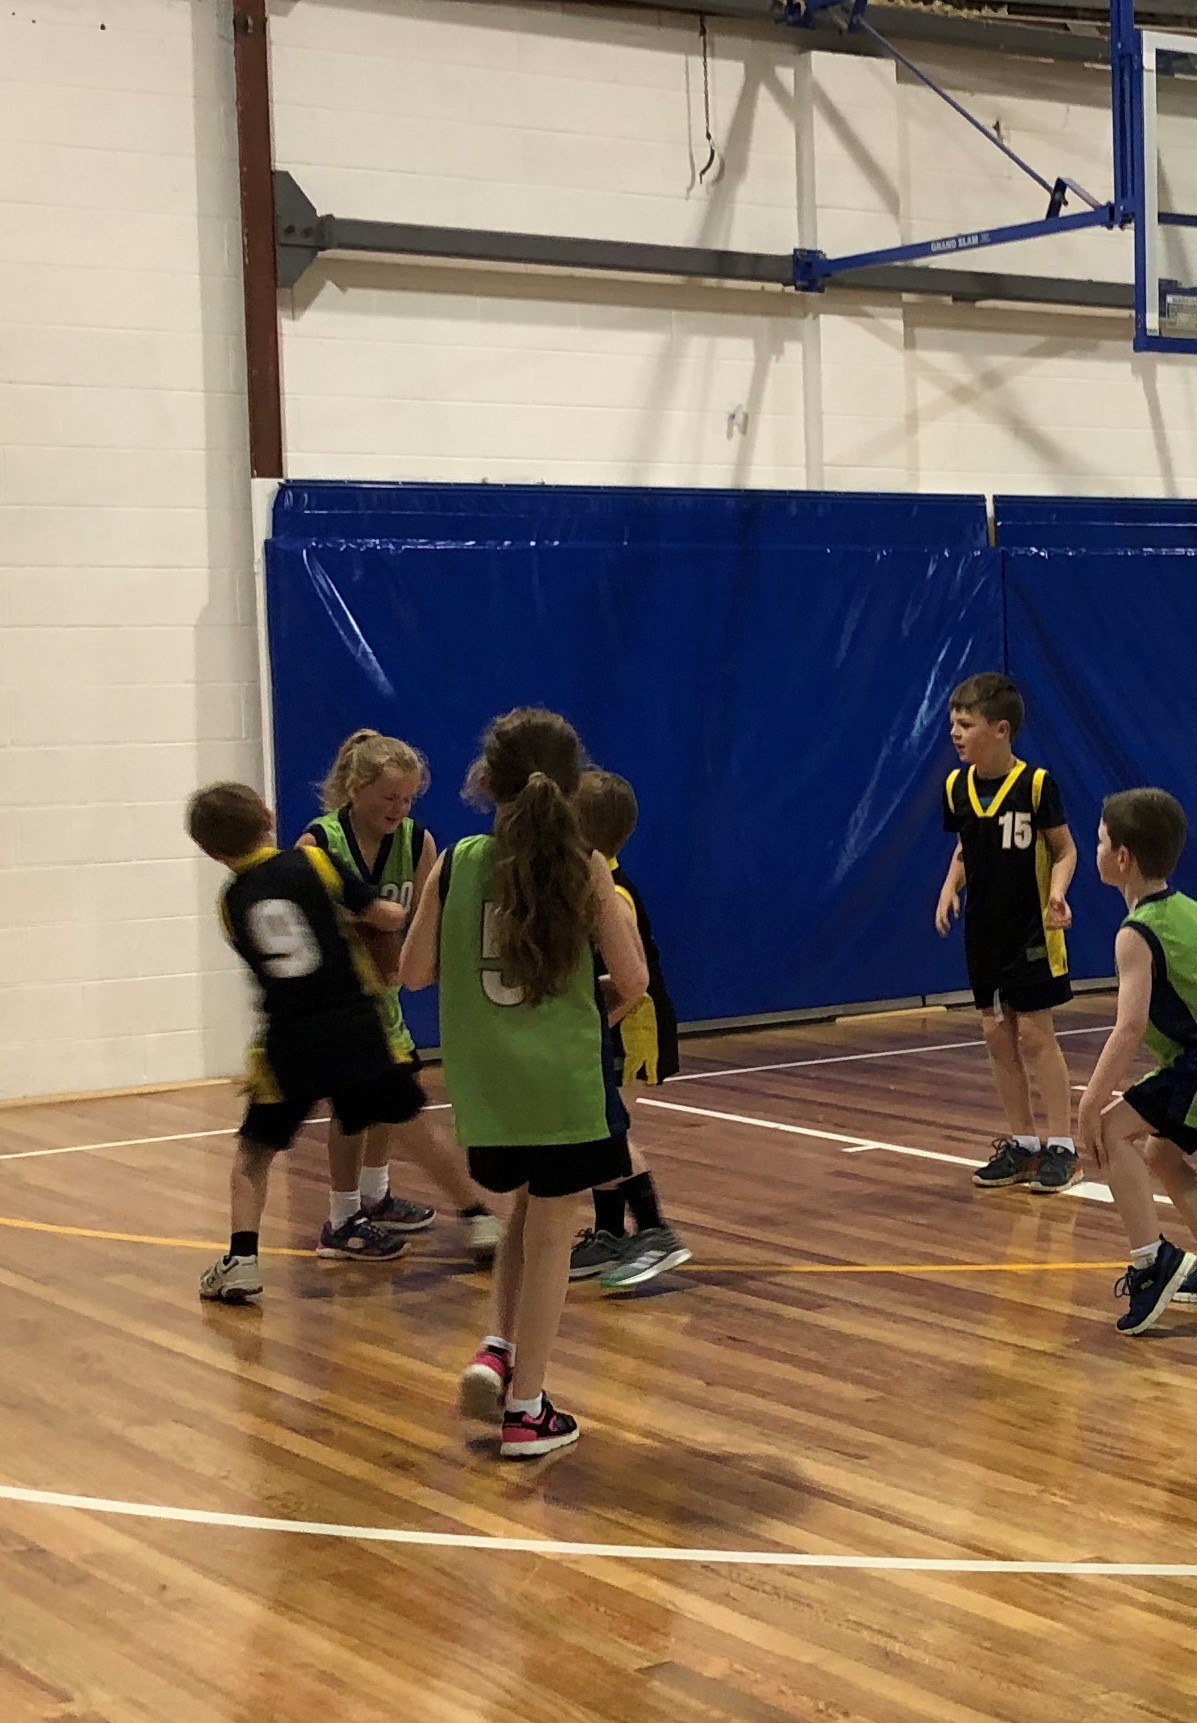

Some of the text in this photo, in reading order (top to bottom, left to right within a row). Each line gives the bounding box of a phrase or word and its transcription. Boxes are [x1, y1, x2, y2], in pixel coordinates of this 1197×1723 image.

[931, 239, 957, 252] GRAND
[957, 234, 979, 248] SLAM
[998, 811, 1033, 850] 15
[247, 898, 322, 979] 9
